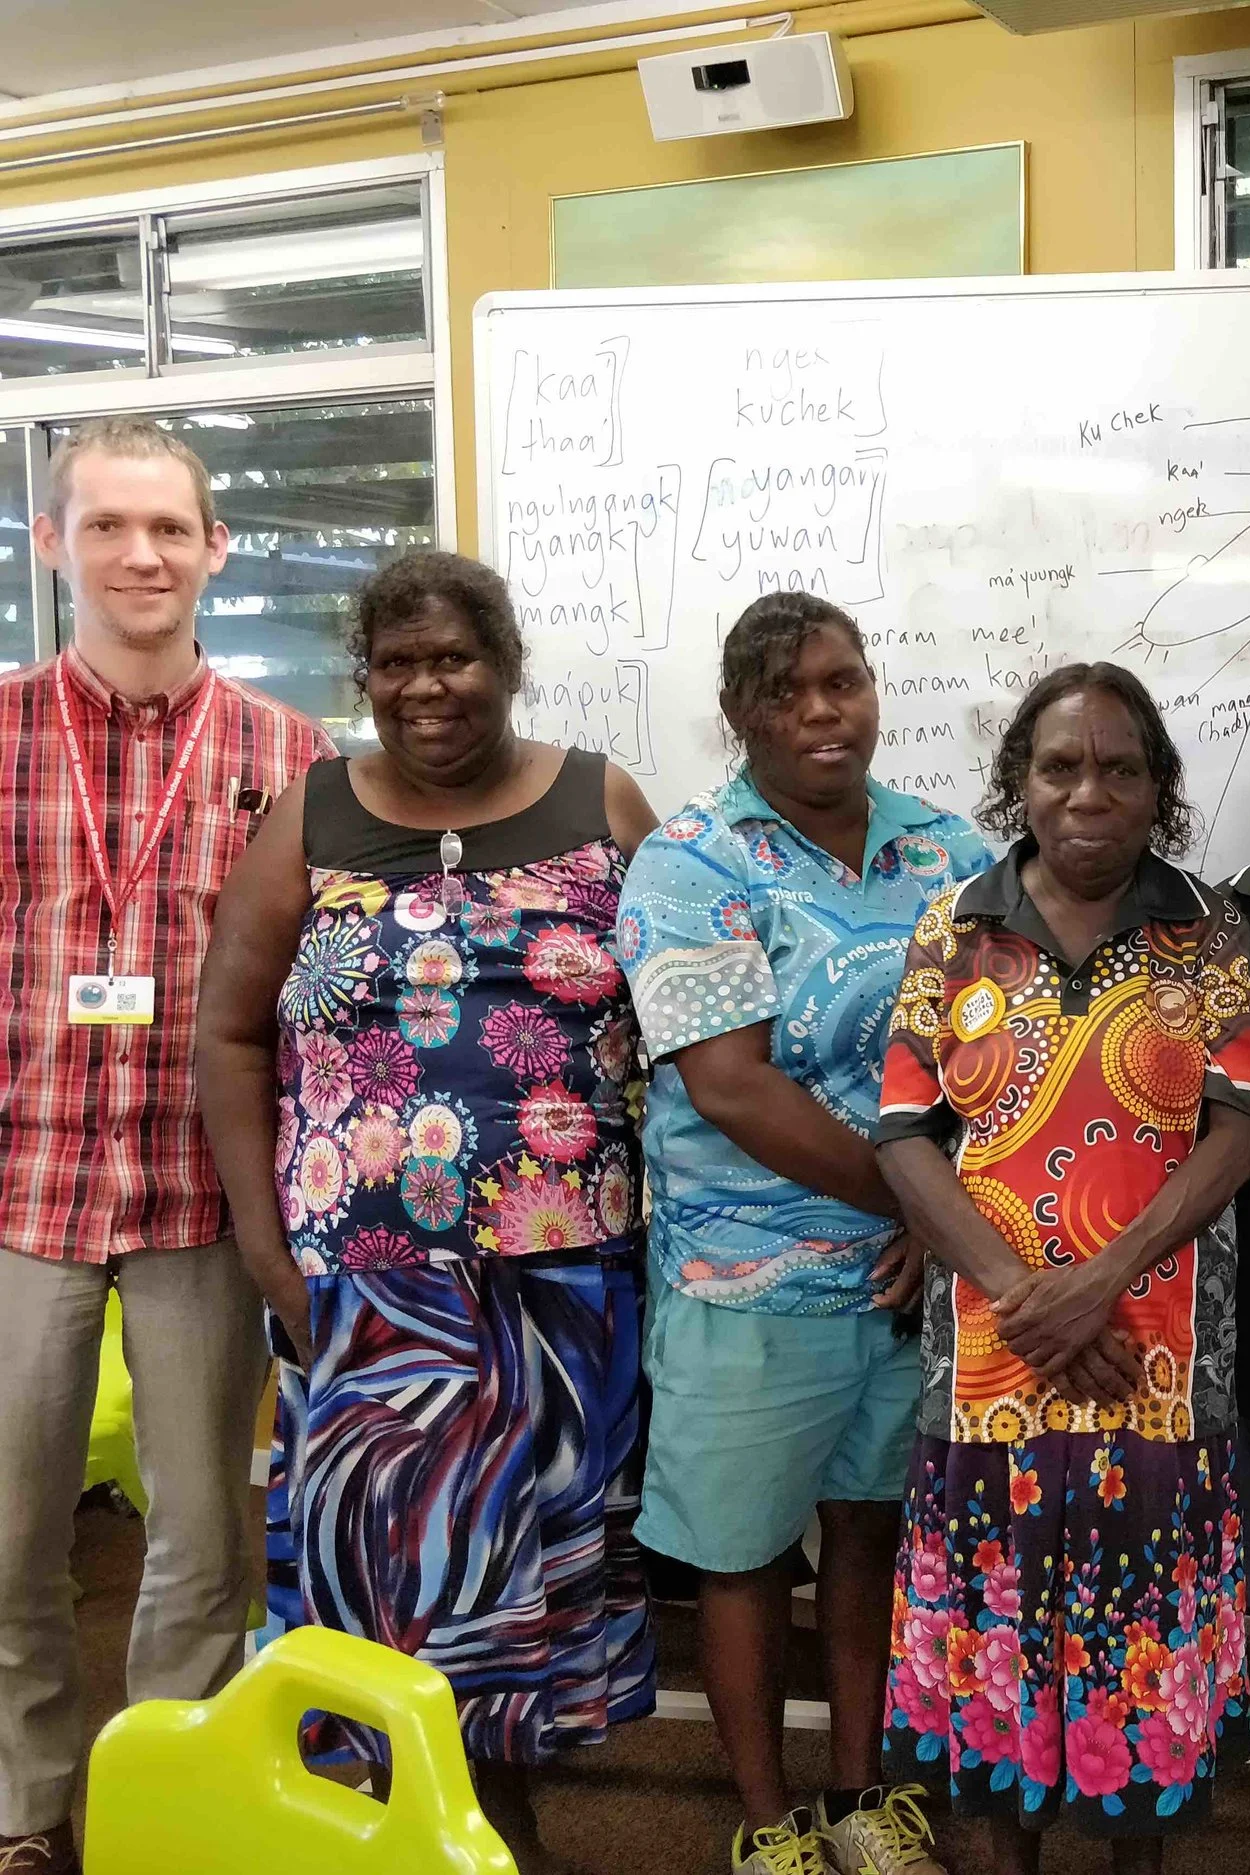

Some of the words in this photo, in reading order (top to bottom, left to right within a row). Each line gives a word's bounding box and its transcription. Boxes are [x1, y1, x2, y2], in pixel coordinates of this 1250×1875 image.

[736, 387, 856, 428] kuchek
[758, 567, 829, 595] man
[826, 937, 910, 985] Language
